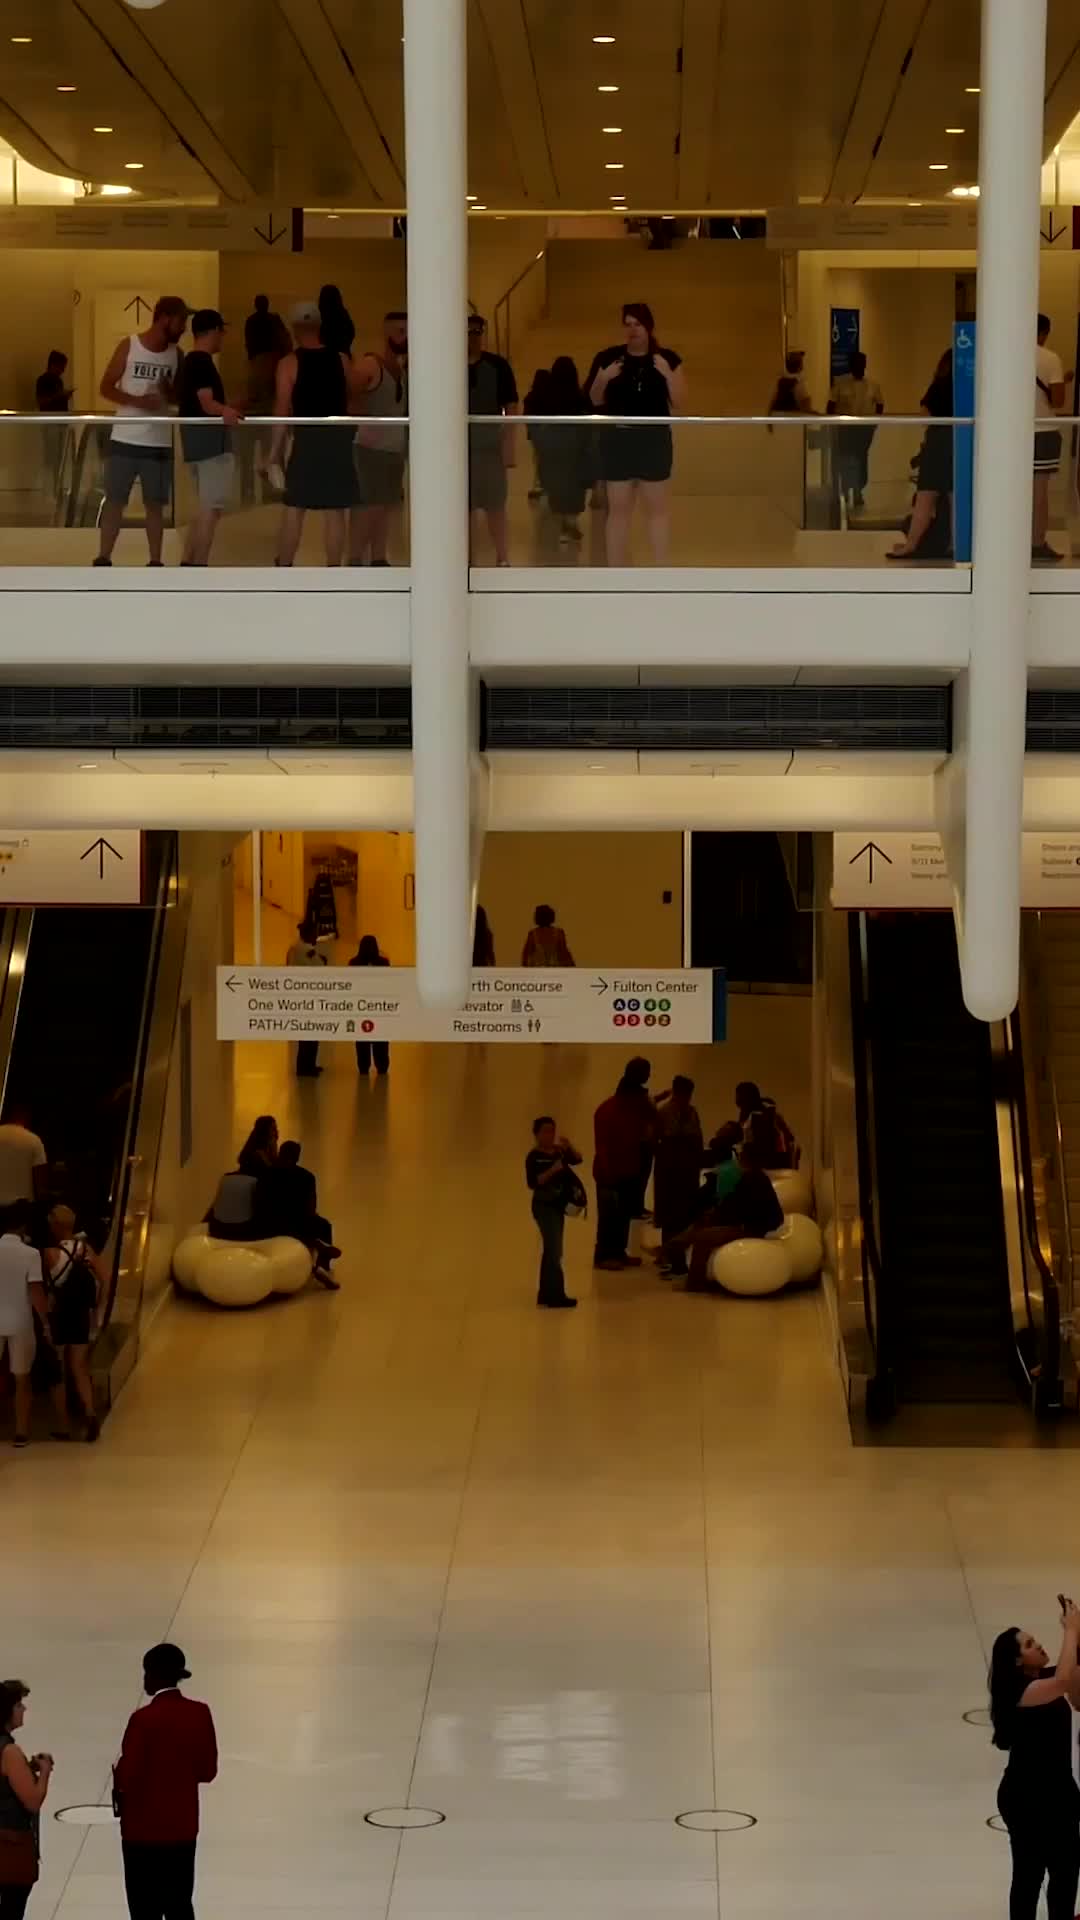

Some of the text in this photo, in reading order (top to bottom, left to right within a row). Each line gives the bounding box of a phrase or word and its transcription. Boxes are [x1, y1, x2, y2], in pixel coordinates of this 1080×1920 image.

[248, 979, 352, 991] West Concourse
[471, 980, 563, 992] rth Concourse
[613, 980, 699, 993] Fulton Center
[248, 1000, 400, 1012] One World Trade Center
[460, 1000, 504, 1012] evator
[249, 1019, 340, 1032] PATH/Subway
[453, 1020, 522, 1032] Restrooms
